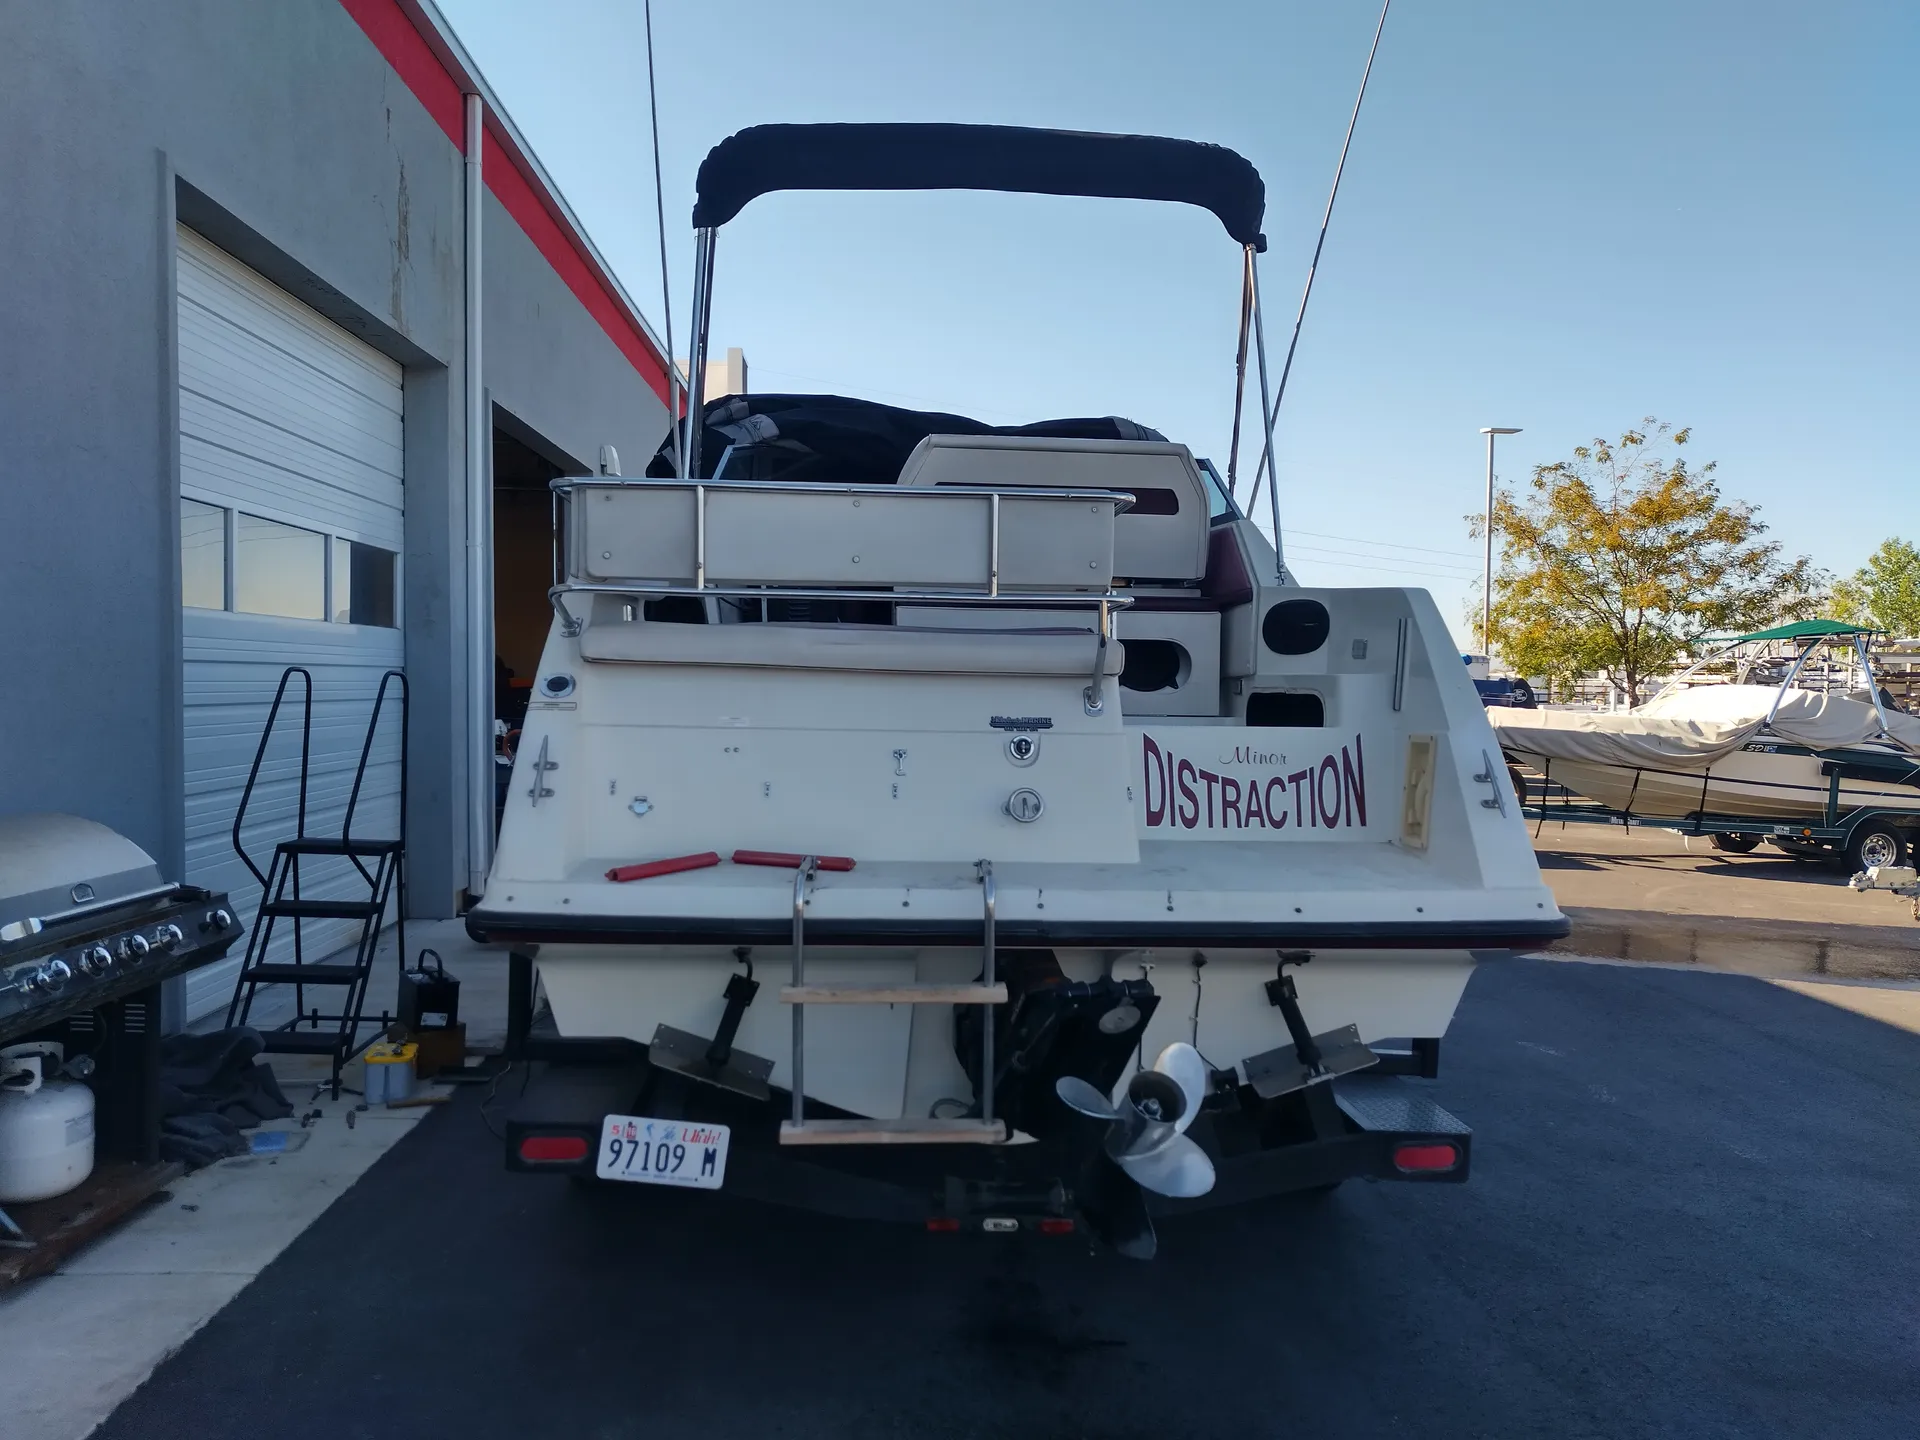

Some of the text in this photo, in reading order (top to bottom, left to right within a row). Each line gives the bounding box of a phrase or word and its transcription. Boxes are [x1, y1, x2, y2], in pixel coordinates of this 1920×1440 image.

[1218, 746, 1288, 766] Minor
[1142, 732, 1367, 830] DISTRACTION
[608, 1138, 717, 1177] 97109 M
